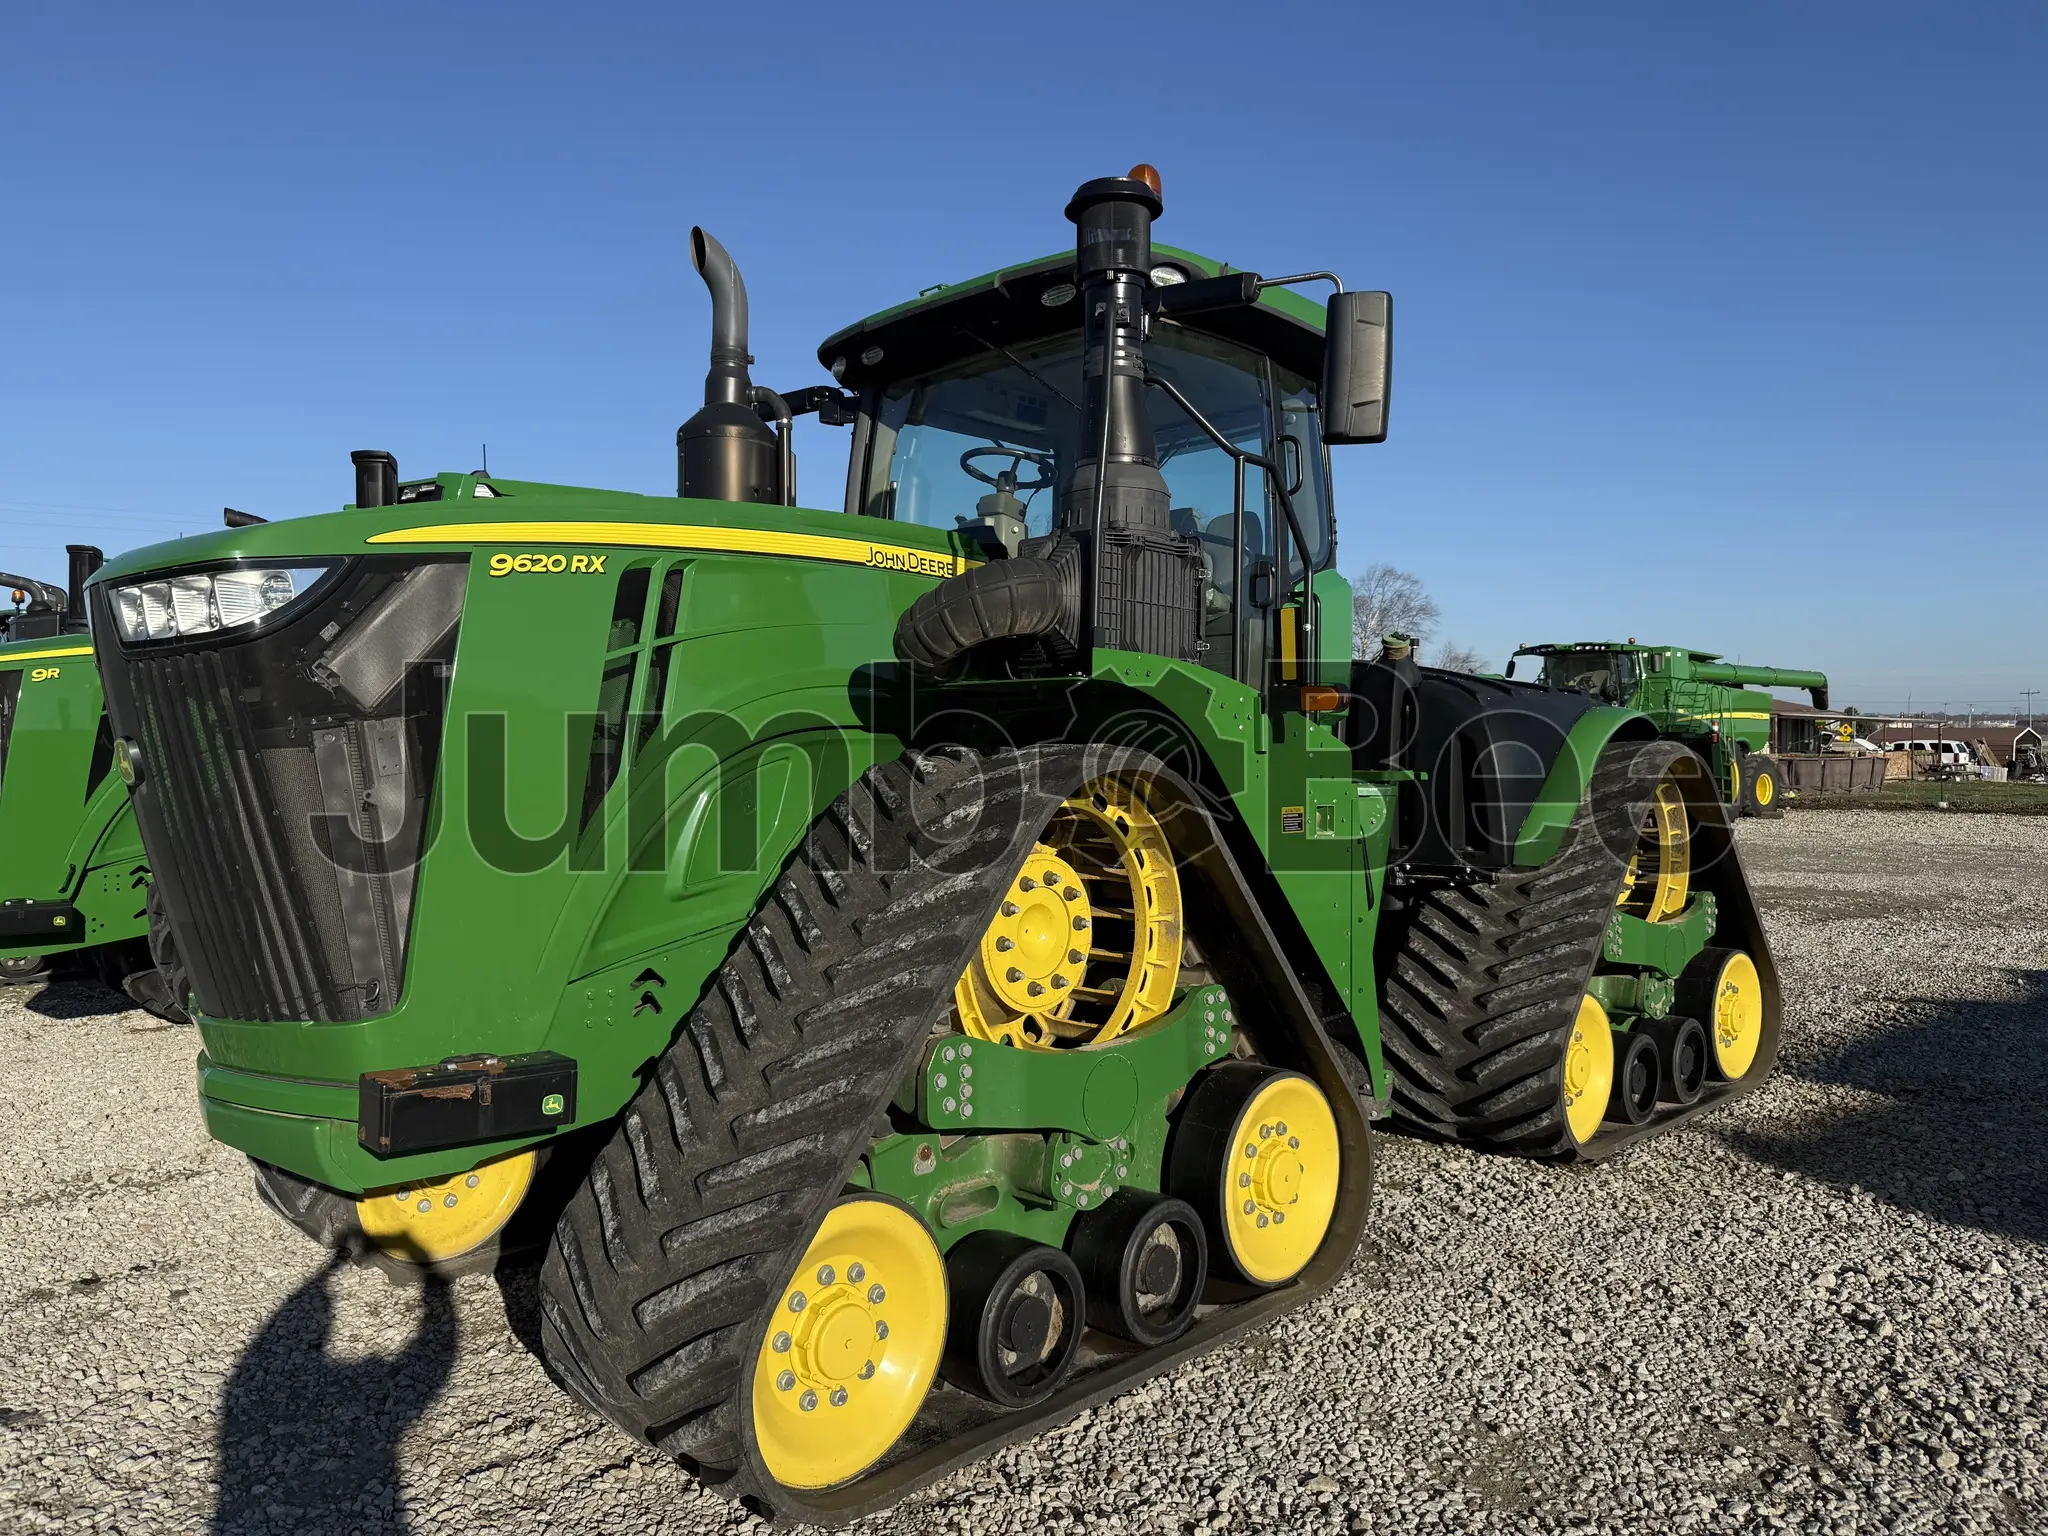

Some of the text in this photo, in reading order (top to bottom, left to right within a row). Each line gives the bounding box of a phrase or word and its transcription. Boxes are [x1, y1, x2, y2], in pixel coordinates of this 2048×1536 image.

[489, 553, 607, 576] 9620 RX
[866, 546, 953, 577] JOHN DEERE
[31, 667, 60, 682] 9R
